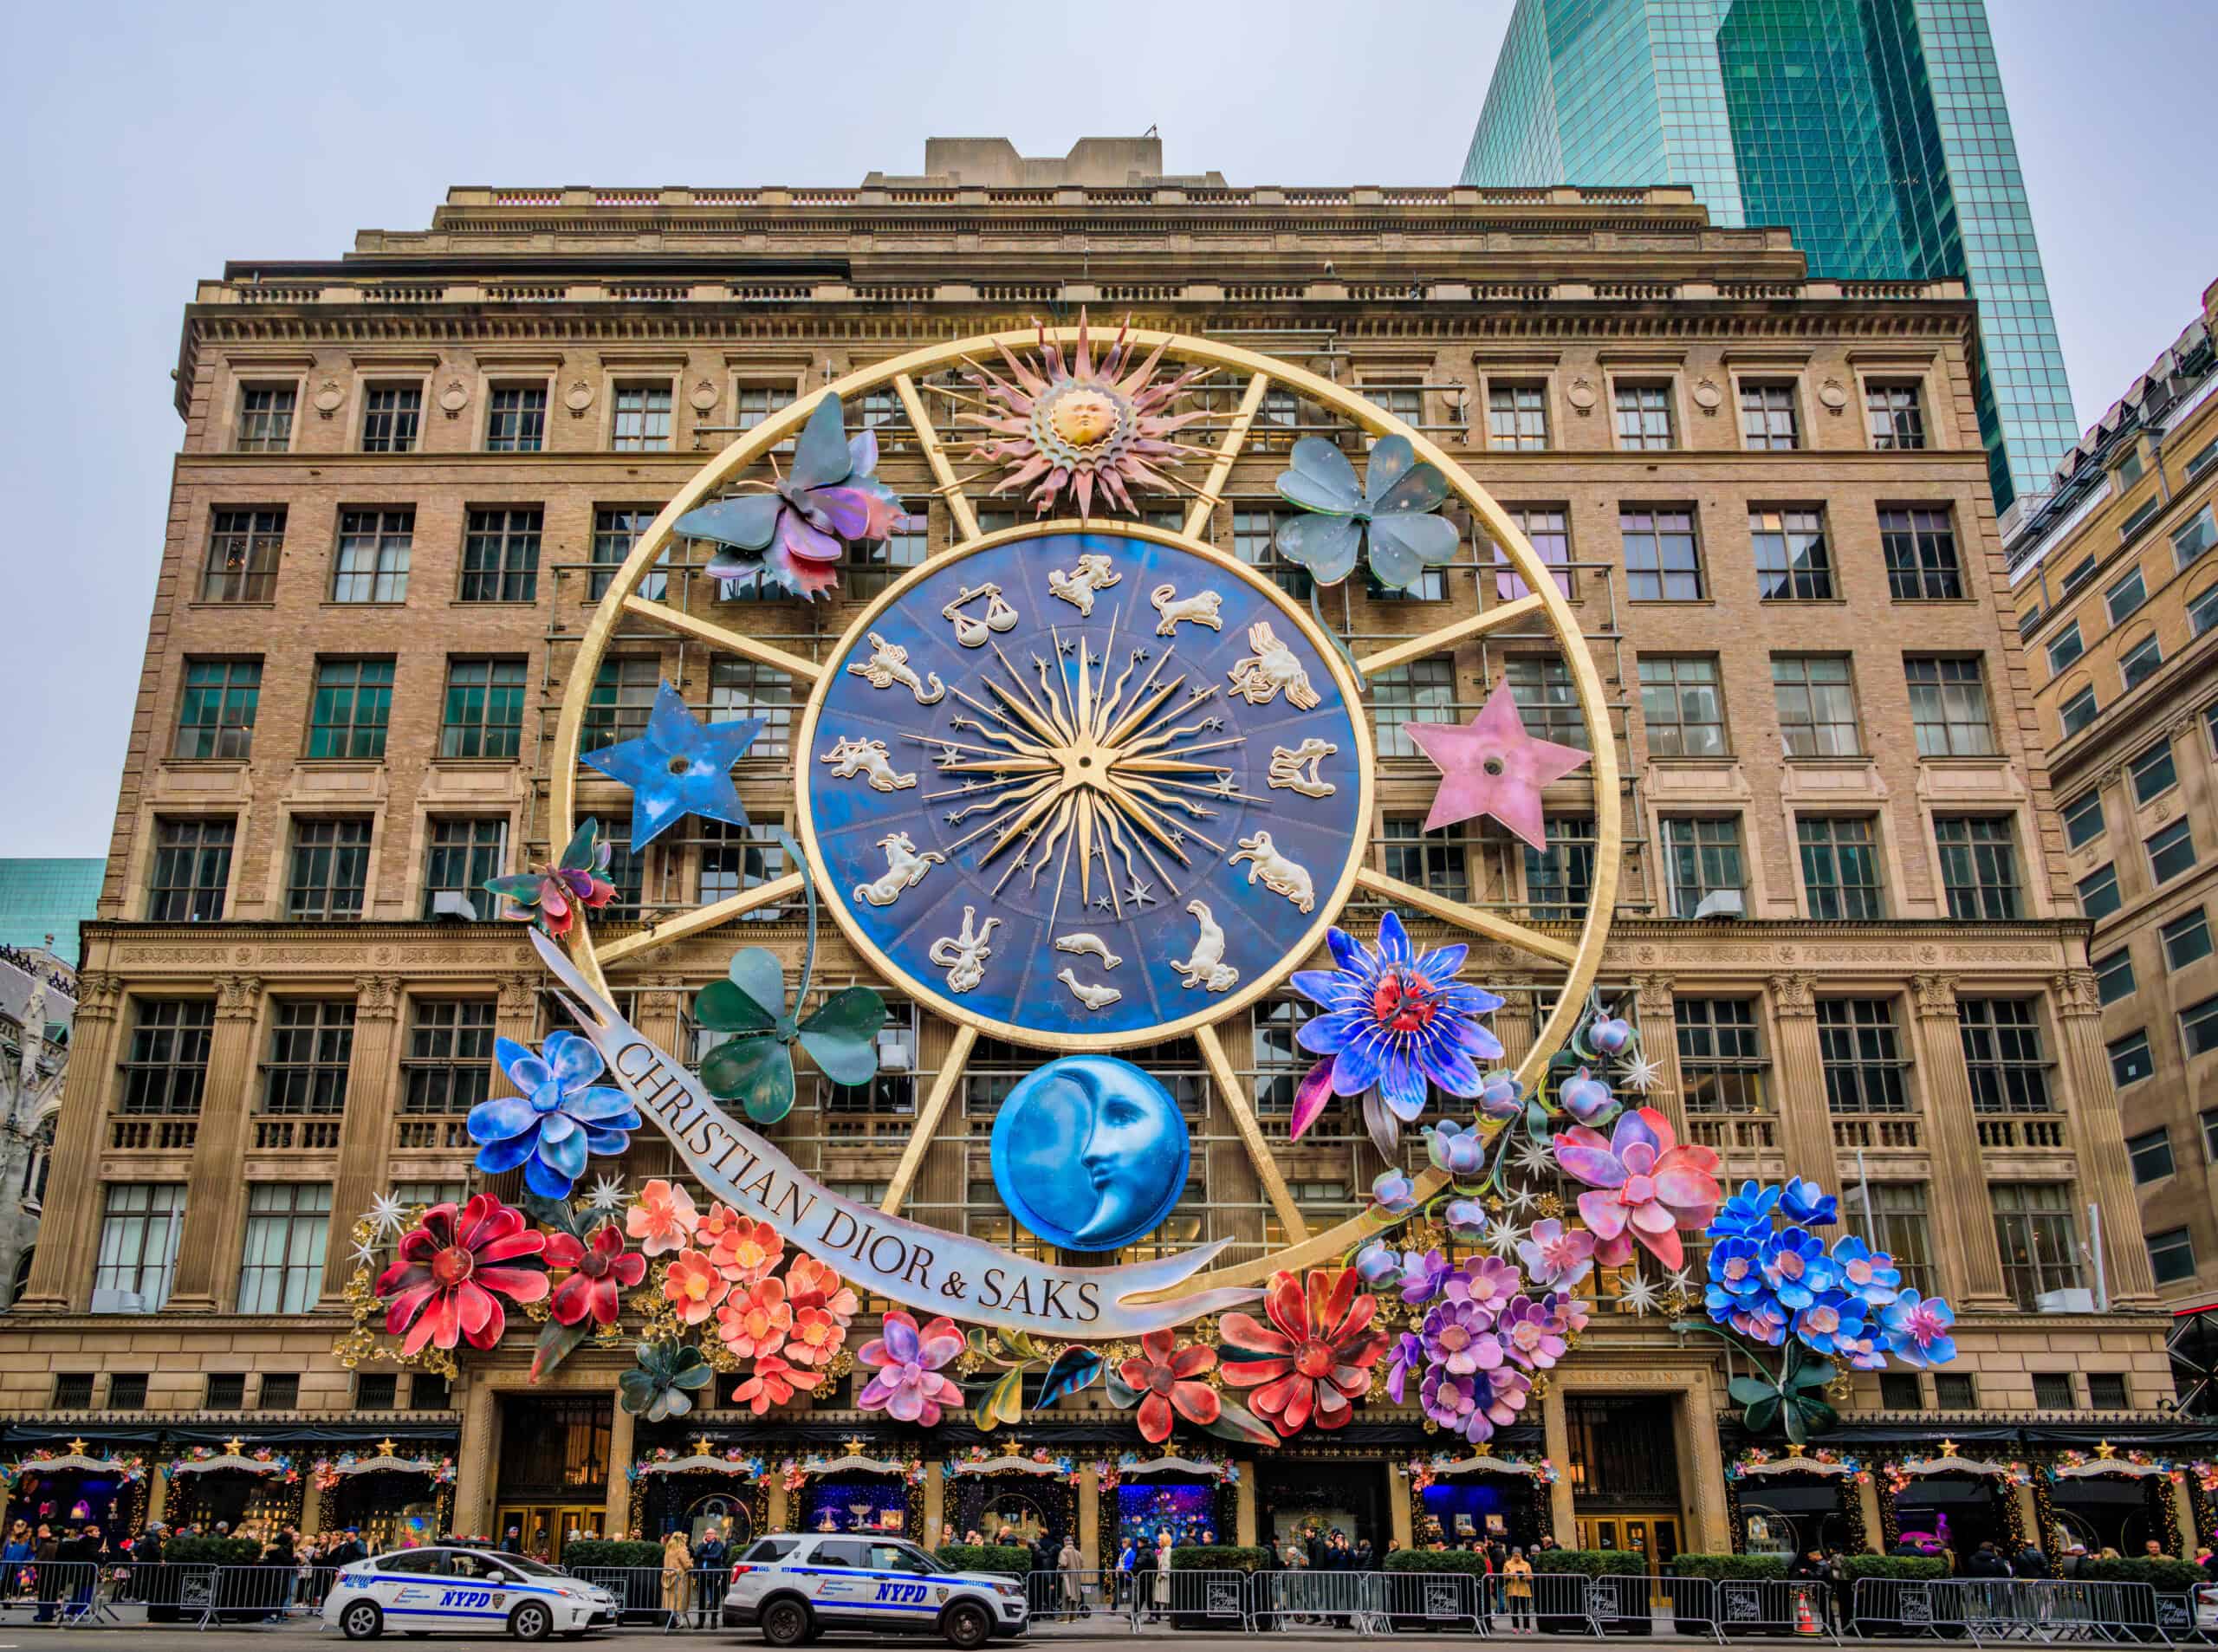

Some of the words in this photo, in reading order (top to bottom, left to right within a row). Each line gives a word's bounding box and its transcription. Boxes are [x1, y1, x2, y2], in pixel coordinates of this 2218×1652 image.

[615, 1041, 819, 1227] CHRISTIAN
[816, 1207, 935, 1291] DIOR
[940, 1270, 968, 1300] &
[977, 1267, 1100, 1323] SAKS
[439, 1591, 491, 1608] NYPD
[874, 1583, 928, 1603] NYPD
